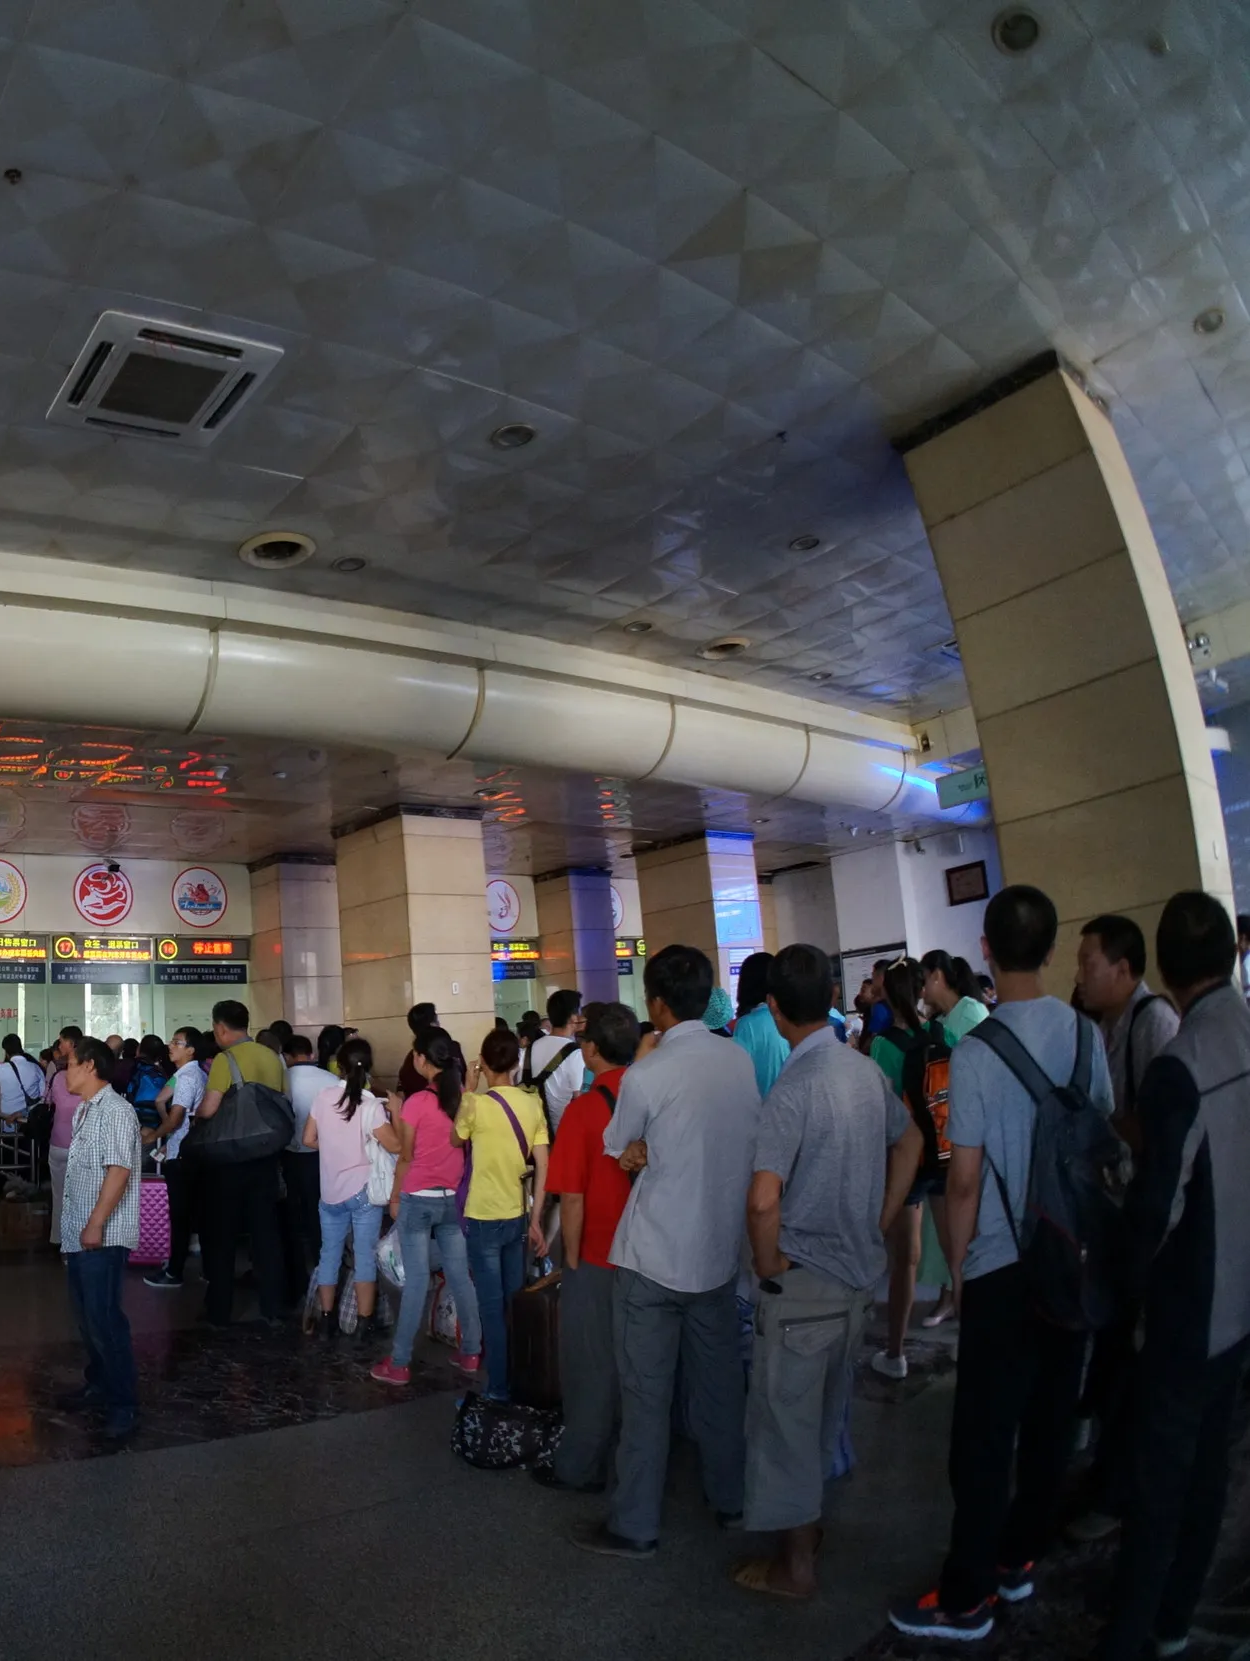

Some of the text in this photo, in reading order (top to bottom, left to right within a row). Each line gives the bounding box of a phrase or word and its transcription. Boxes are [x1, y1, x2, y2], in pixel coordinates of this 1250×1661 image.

[59, 941, 72, 953] 17
[192, 941, 233, 955] 停止售票
